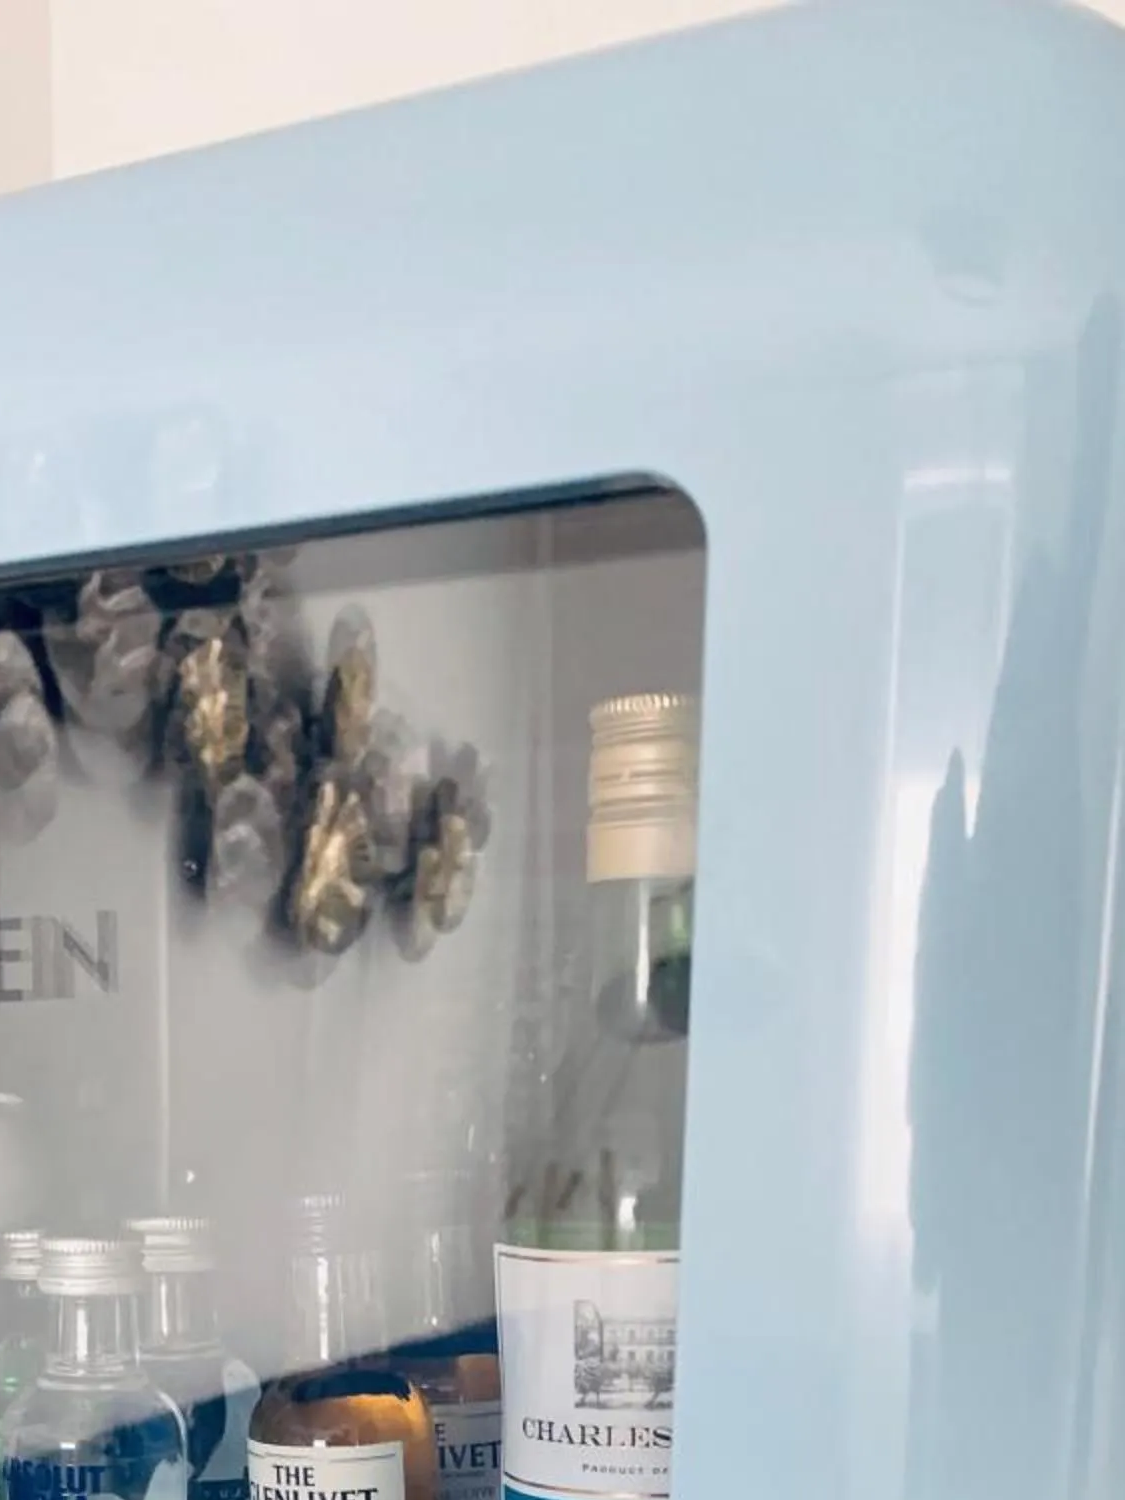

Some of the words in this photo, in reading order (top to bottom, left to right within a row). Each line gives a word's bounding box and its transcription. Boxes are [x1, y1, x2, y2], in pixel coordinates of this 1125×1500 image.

[522, 1417, 672, 1449] CHARLES
[272, 1463, 315, 1487] THE
[581, 1463, 644, 1475] PRODUCT
